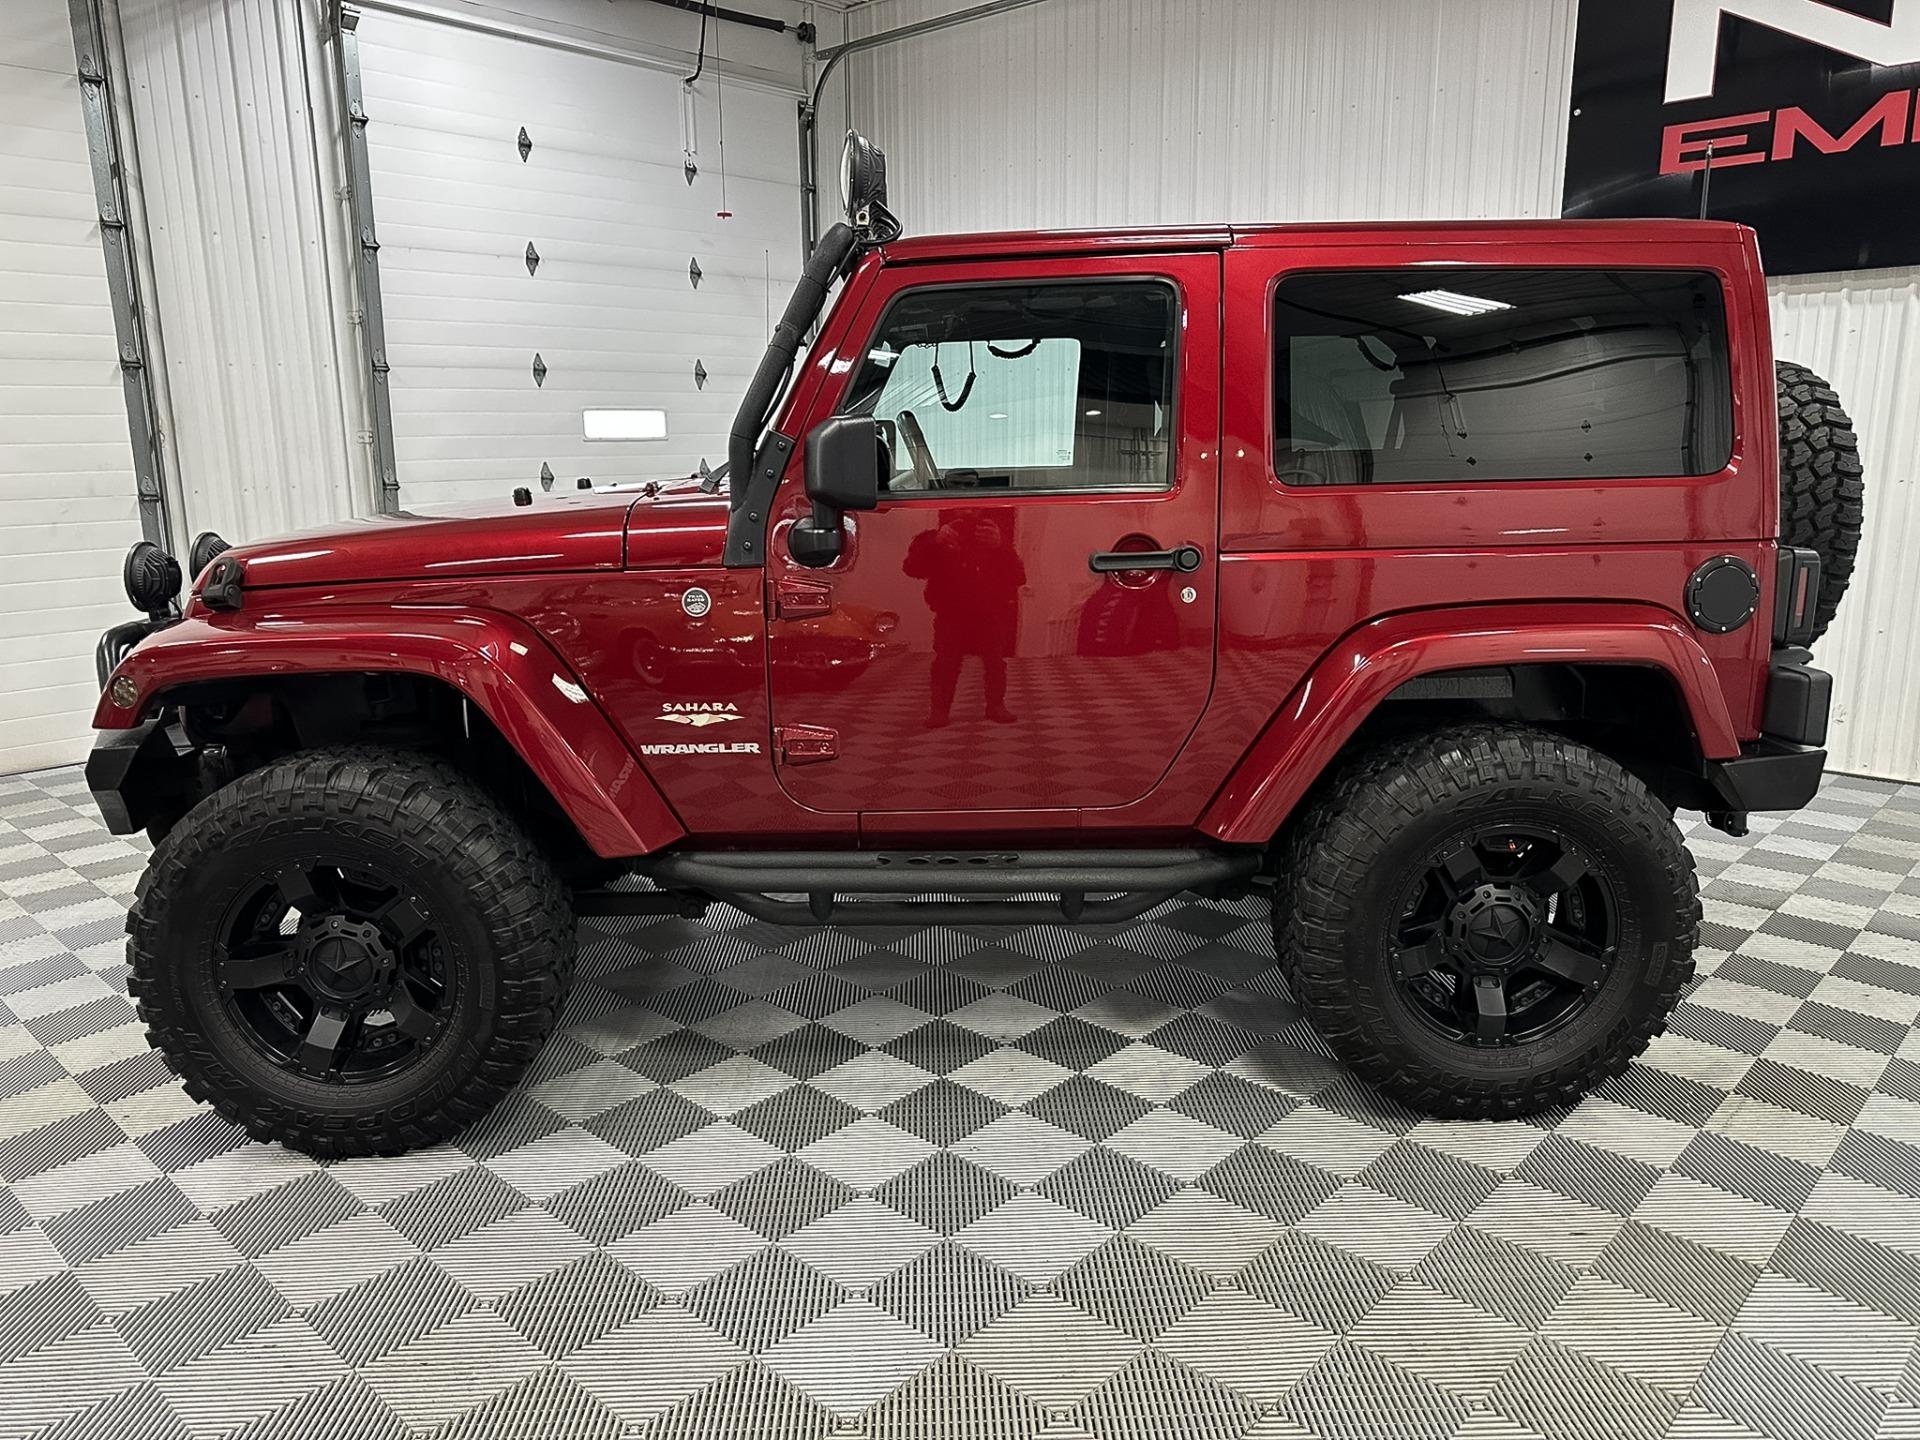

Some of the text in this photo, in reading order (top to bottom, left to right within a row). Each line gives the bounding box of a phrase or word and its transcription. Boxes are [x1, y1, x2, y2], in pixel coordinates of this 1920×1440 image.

[1659, 87, 1920, 175] EM
[662, 702, 738, 712] SAHARA
[640, 742, 761, 755] WRANGLER
